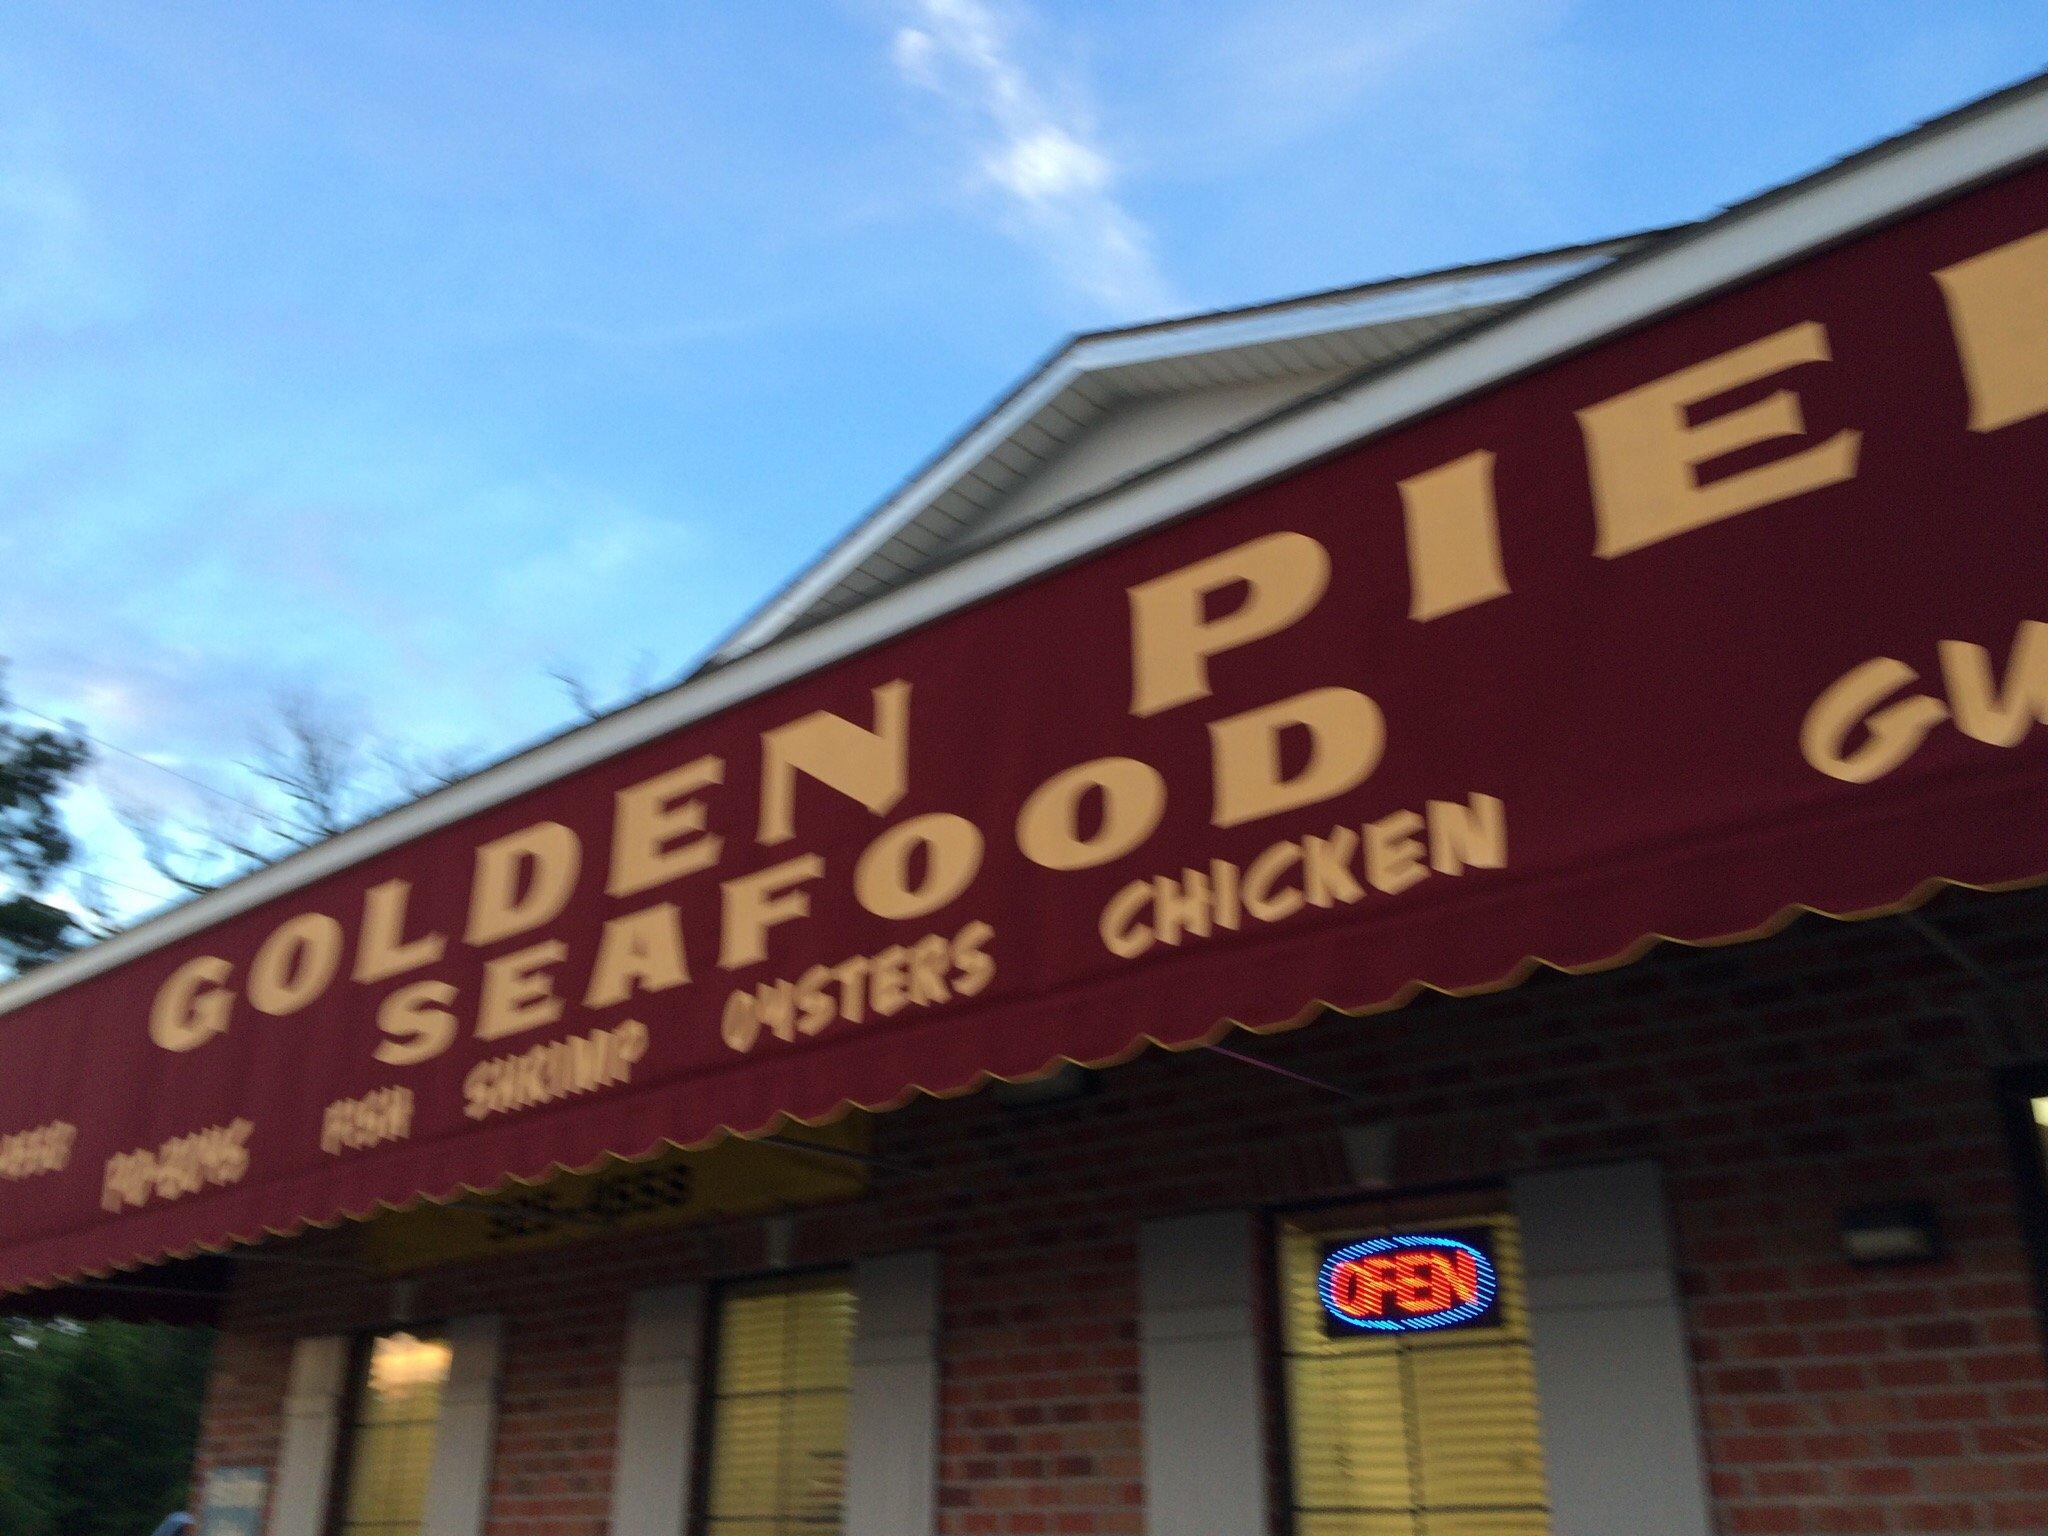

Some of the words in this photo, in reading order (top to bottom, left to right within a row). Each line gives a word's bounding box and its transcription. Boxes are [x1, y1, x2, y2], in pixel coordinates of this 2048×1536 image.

[150, 680, 909, 1053] GOLDEN
[374, 685, 1384, 1067] SEAFOOD
[463, 1019, 650, 1121] SHRIMP
[721, 919, 997, 1053] OYSTERS
[1099, 791, 1507, 960] CHICKEN
[1331, 1249, 1479, 1317] OPEN
